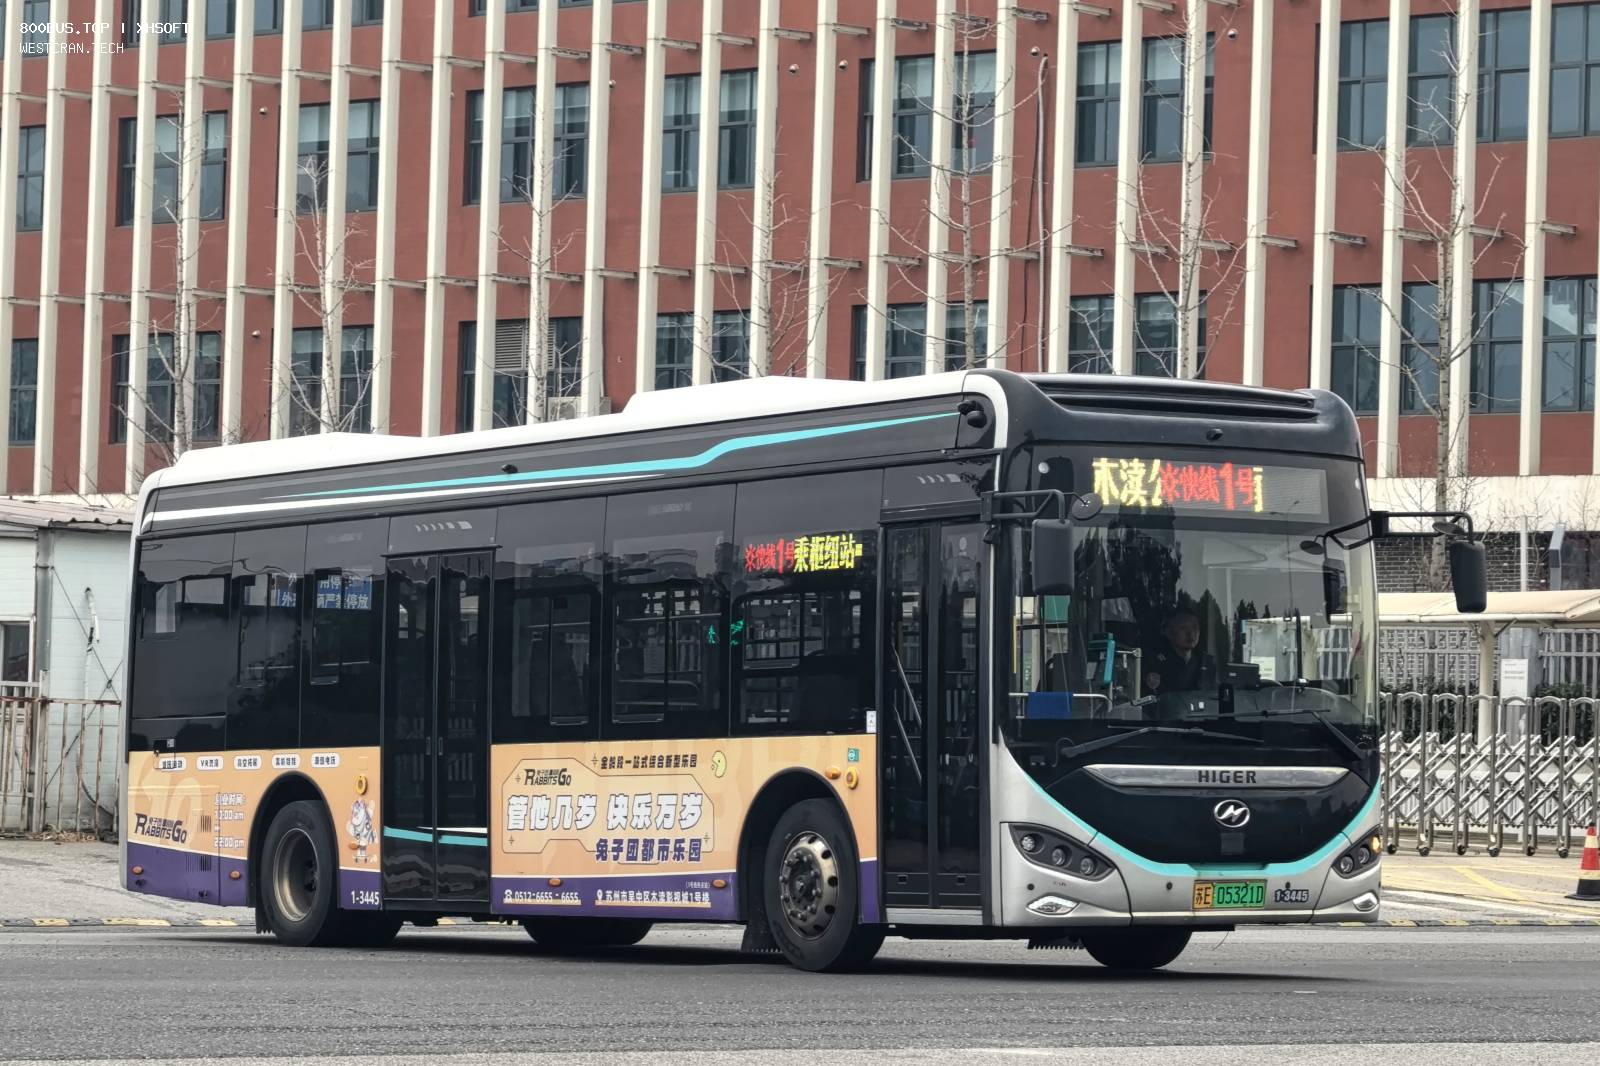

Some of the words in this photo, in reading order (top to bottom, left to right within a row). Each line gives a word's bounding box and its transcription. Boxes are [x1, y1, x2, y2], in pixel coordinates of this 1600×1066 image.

[1198, 770, 1257, 784] HIGER
[507, 794, 598, 831] 管他几岁
[606, 793, 704, 831] 快乐万岁
[596, 838, 702, 862] 兔子团都市乐园
[350, 890, 380, 905] 1-3445
[1274, 889, 1309, 902] 1-3445
